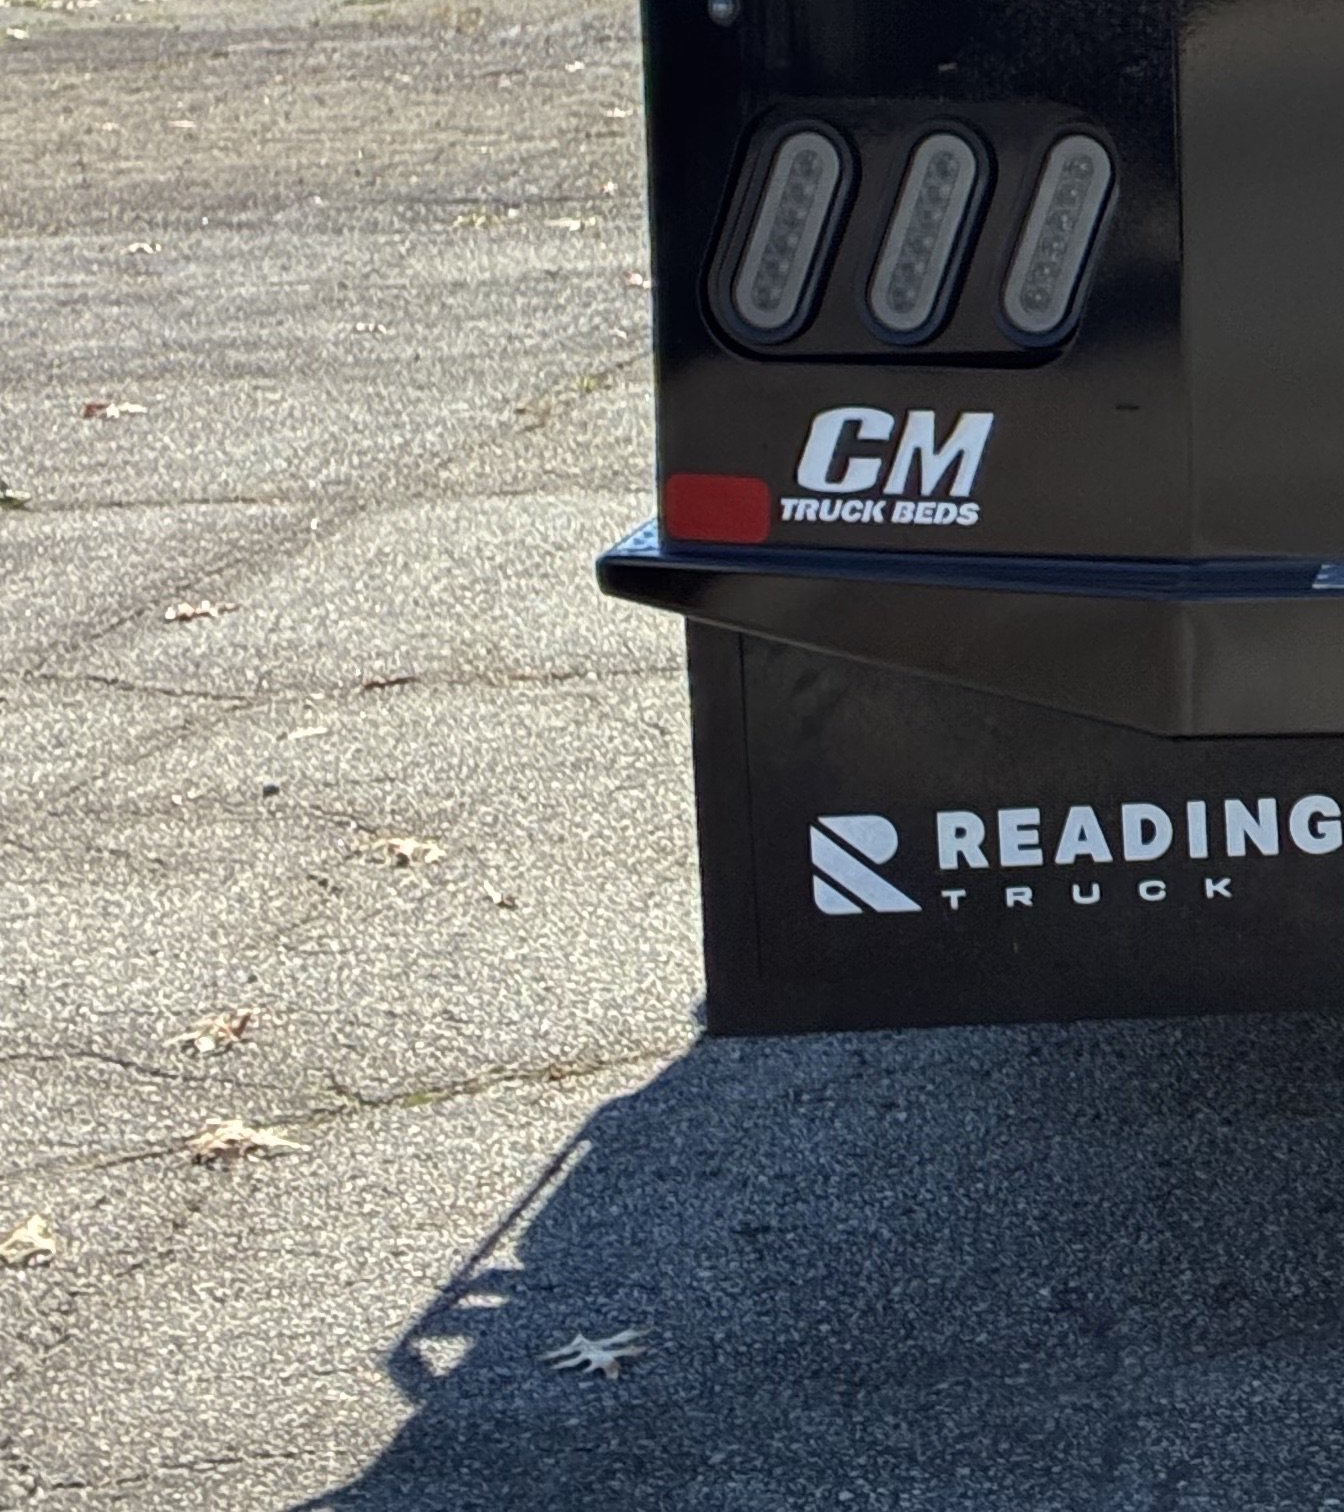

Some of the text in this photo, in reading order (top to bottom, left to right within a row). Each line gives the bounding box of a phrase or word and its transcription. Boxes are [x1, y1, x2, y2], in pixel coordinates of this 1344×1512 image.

[796, 406, 995, 498] CM
[780, 497, 981, 526] TRUCK BEDS
[936, 794, 1344, 871] READING
[941, 876, 1233, 911] TRUCK
